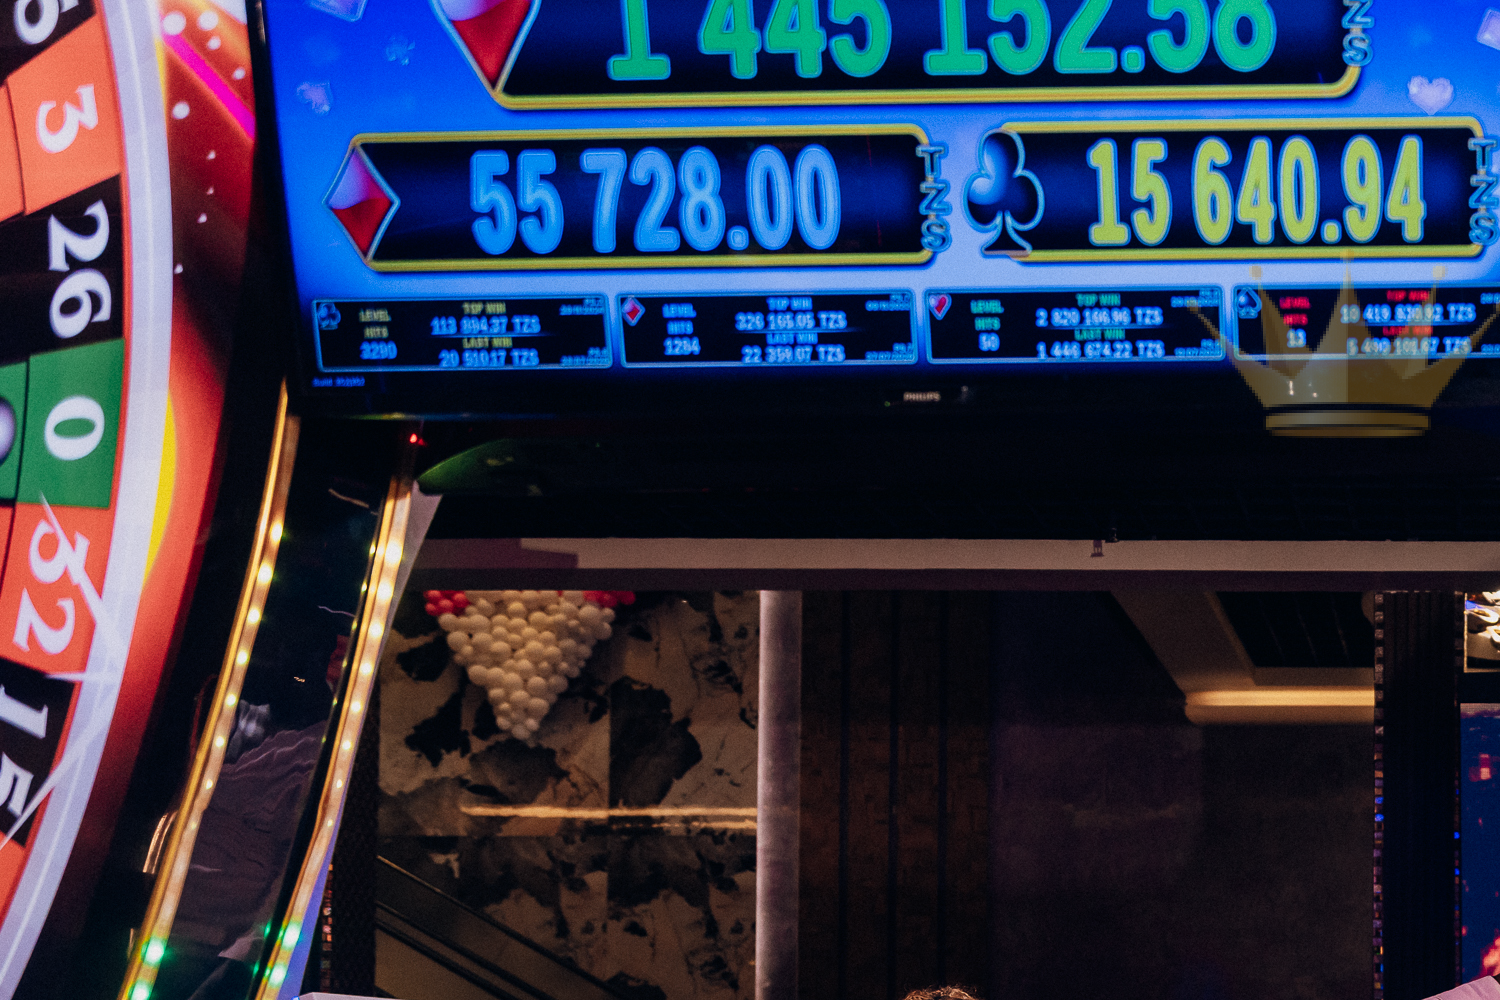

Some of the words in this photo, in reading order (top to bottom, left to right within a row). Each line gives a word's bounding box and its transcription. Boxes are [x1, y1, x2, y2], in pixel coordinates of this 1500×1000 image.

[36, 84, 99, 154] 3
[470, 149, 564, 255] 55
[580, 144, 842, 253] 728.00
[916, 144, 953, 252] TZS
[1087, 138, 1172, 246] 15
[1195, 136, 1427, 245] 640.94
[1469, 136, 1500, 247] TZS
[48, 199, 112, 339] 26
[970, 299, 1004, 314] LEVEL
[1076, 293, 1098, 306] TOP
[1100, 293, 1121, 305] WIN
[359, 309, 391, 322] LEVEL
[662, 303, 697, 318] LEVEL
[817, 311, 847, 329] TZS
[1035, 308, 1048, 327] 2
[1133, 306, 1163, 325] TZS
[511, 315, 541, 333] TZS
[438, 350, 459, 367] 20
[741, 345, 762, 363] 22
[44, 395, 104, 461] 0
[13, 519, 90, 655] 32
